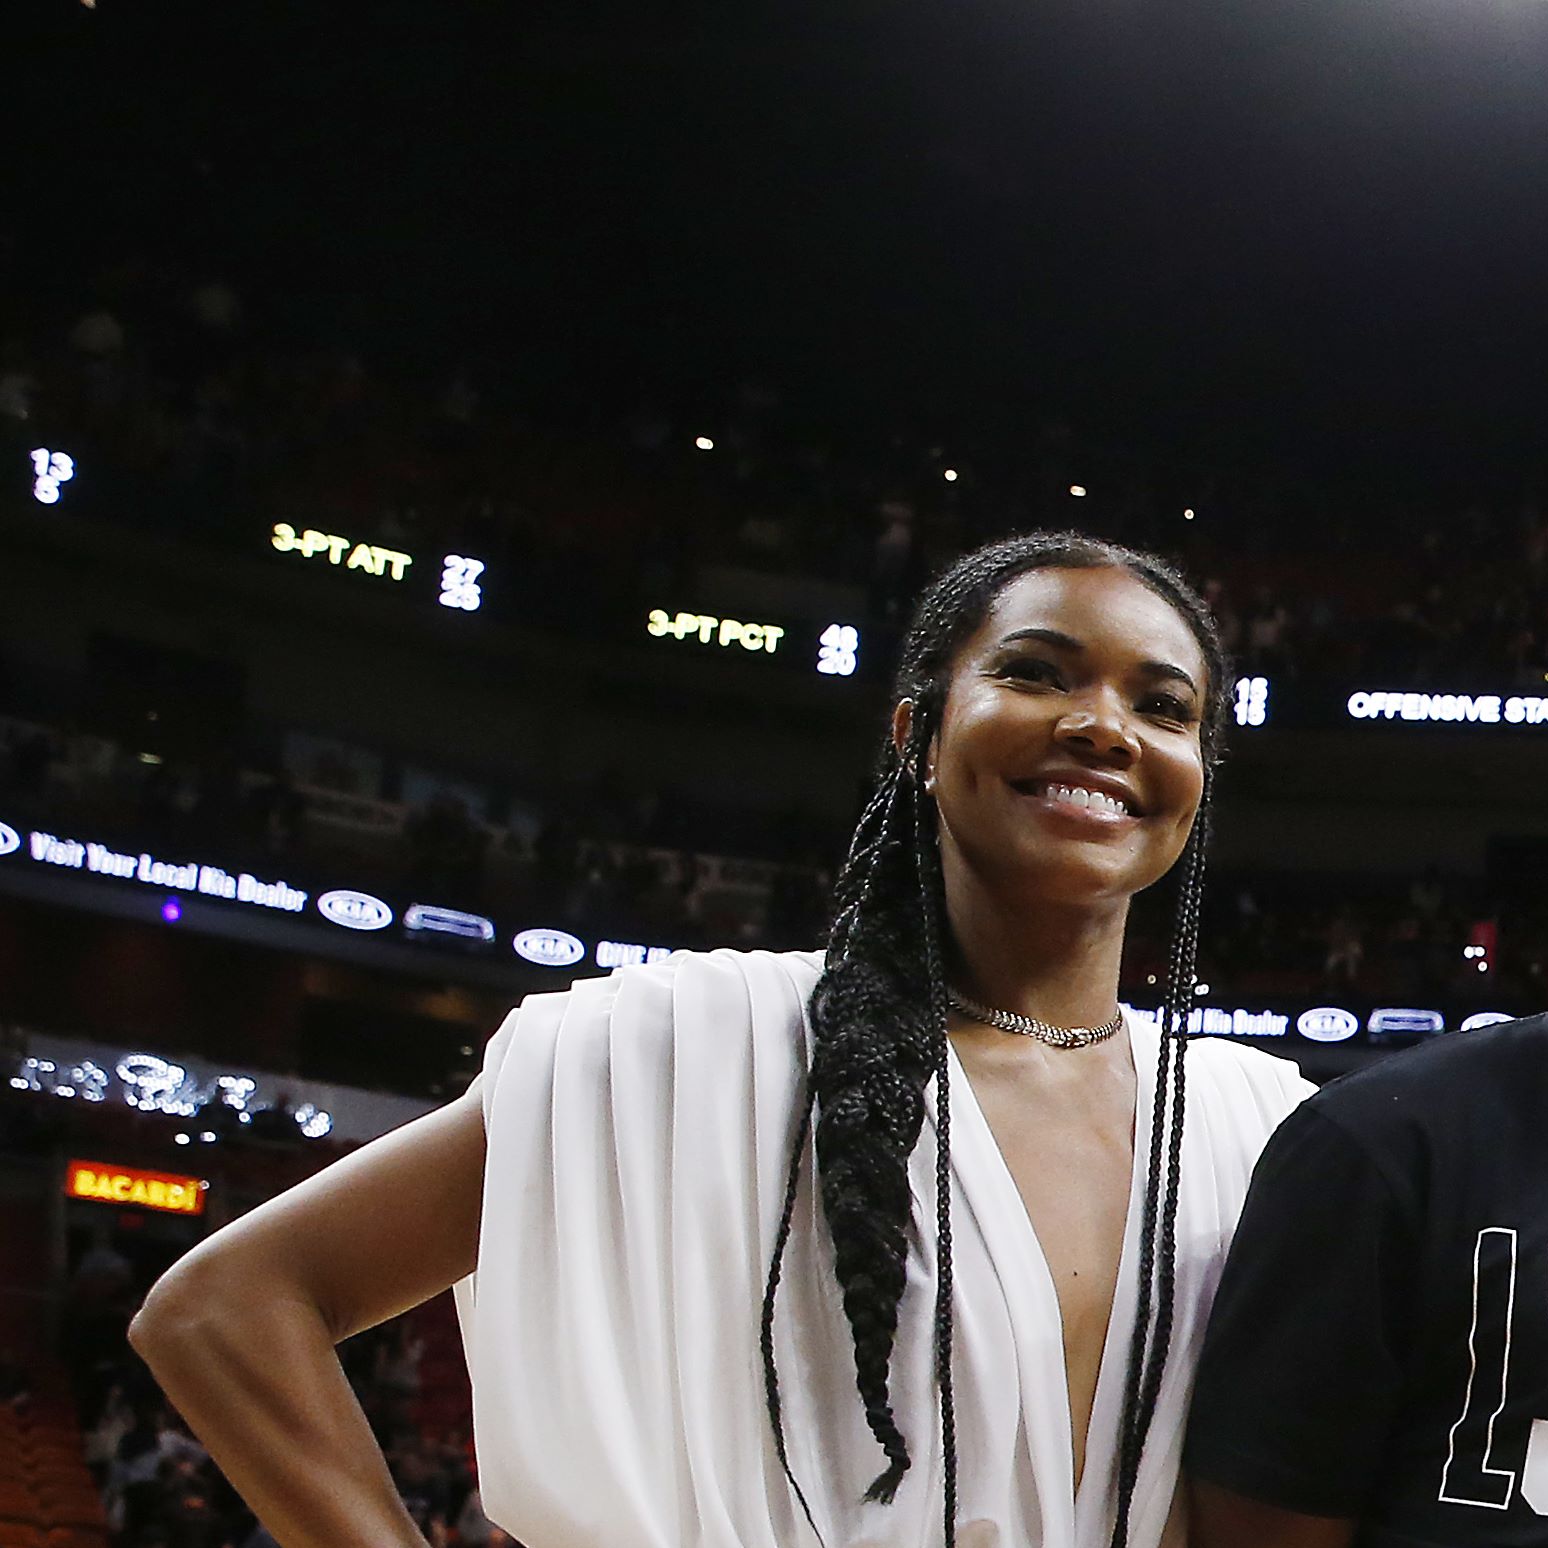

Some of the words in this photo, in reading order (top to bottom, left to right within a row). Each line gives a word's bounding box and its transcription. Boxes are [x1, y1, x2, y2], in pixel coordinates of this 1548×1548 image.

[30, 447, 75, 482] 13
[271, 523, 350, 564] 3-PT
[347, 543, 412, 580] ATT
[647, 609, 719, 644] 3-PT
[718, 619, 785, 654] PCT
[1347, 691, 1501, 724] OFFENSIVE
[137, 853, 199, 891] Local
[236, 873, 308, 912] Dealer
